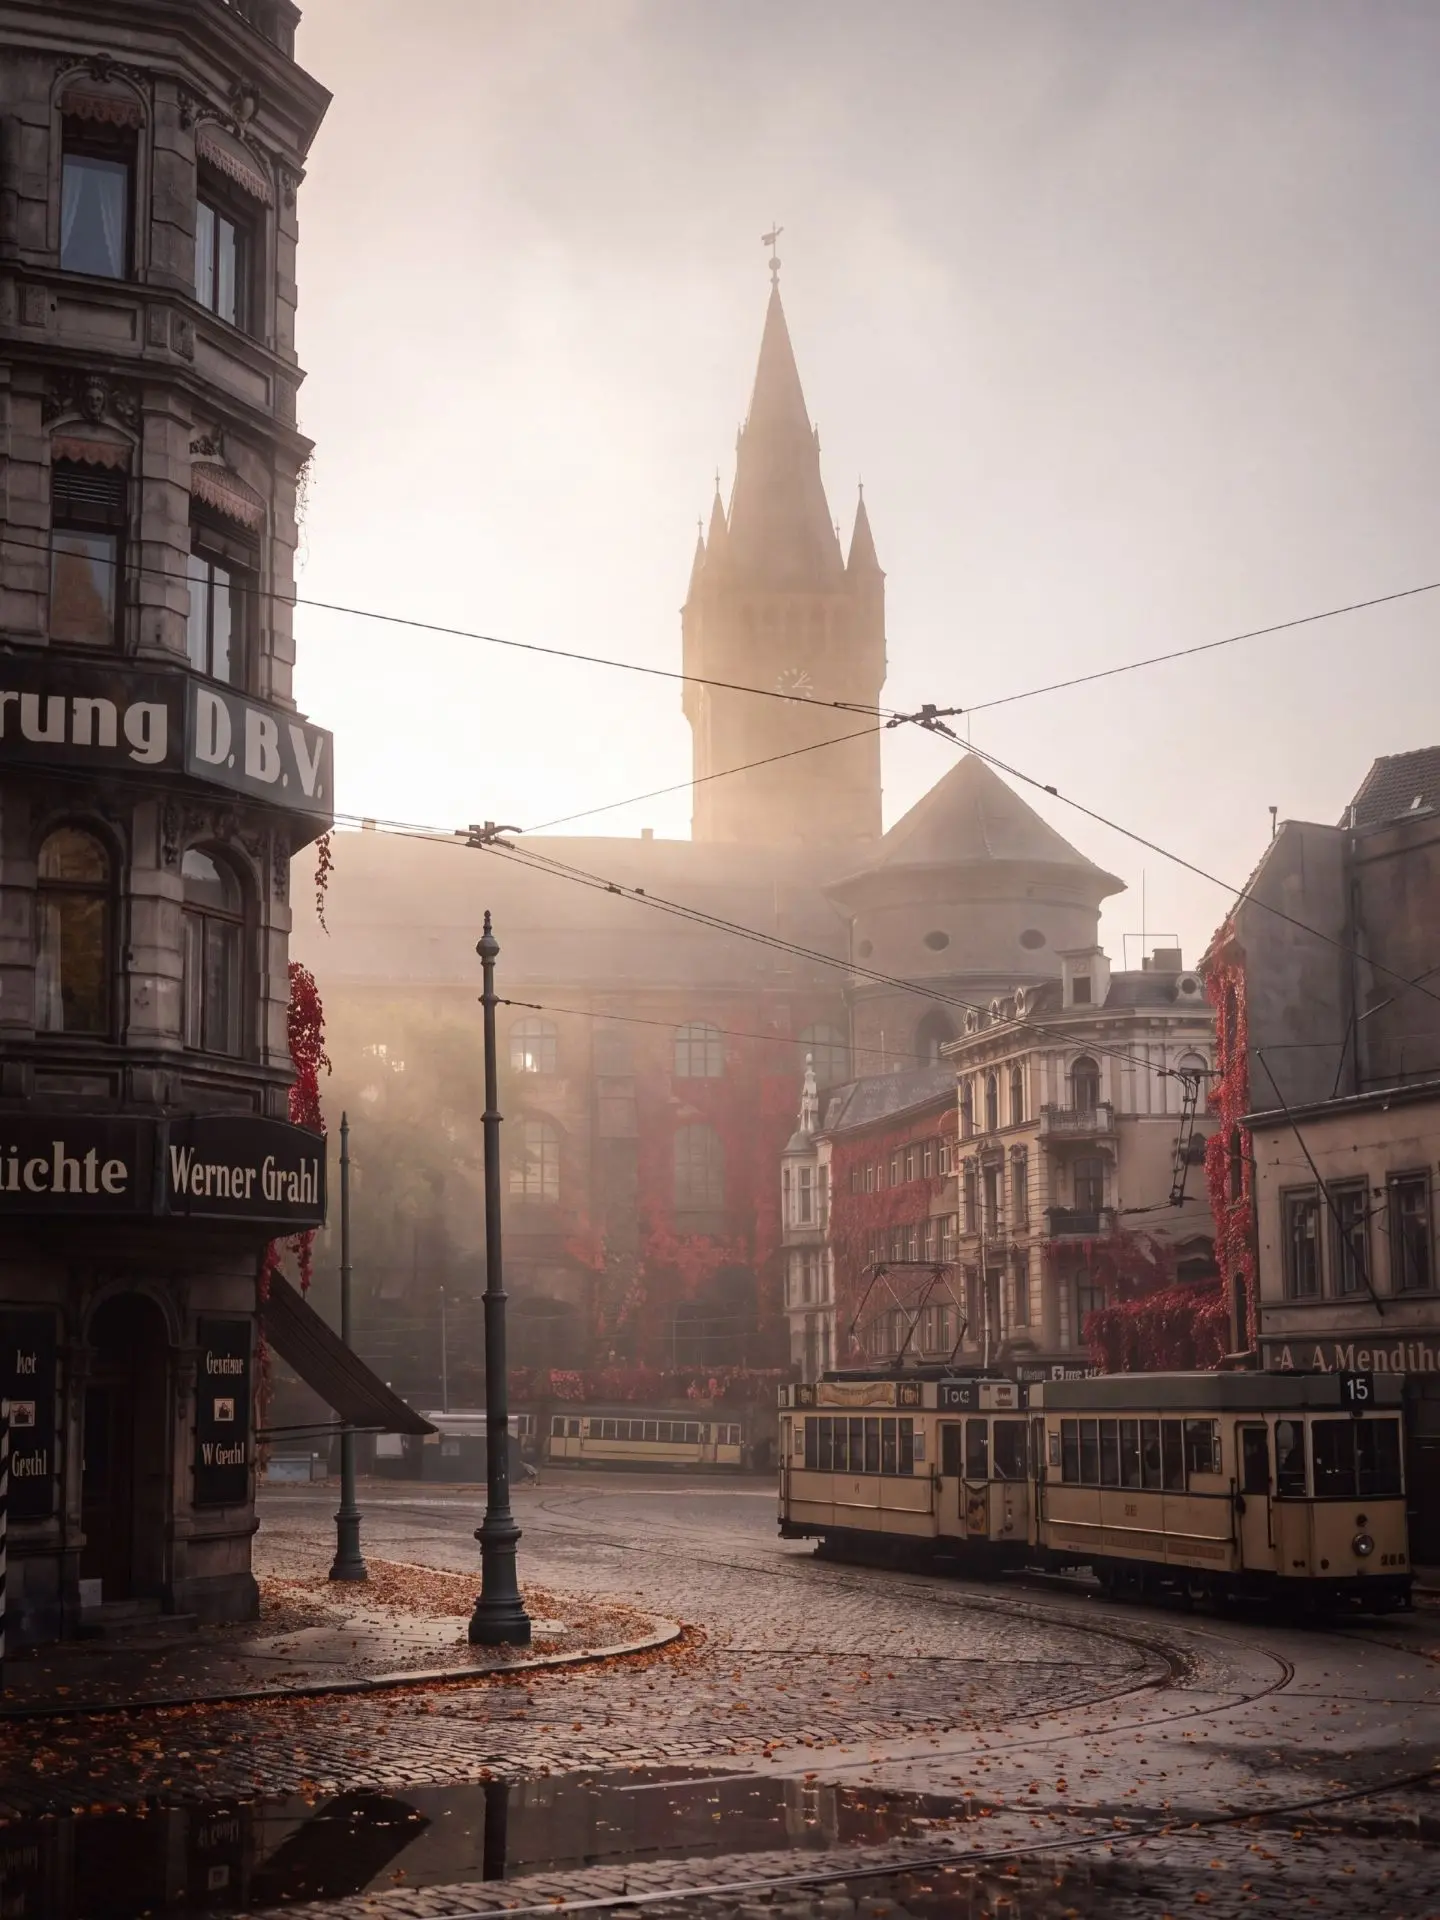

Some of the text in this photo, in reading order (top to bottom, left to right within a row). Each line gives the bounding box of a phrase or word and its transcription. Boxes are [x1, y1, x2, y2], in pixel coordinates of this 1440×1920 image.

[169, 1145, 319, 1204] Werner Grahl
[1347, 1378, 1368, 1400] 15
